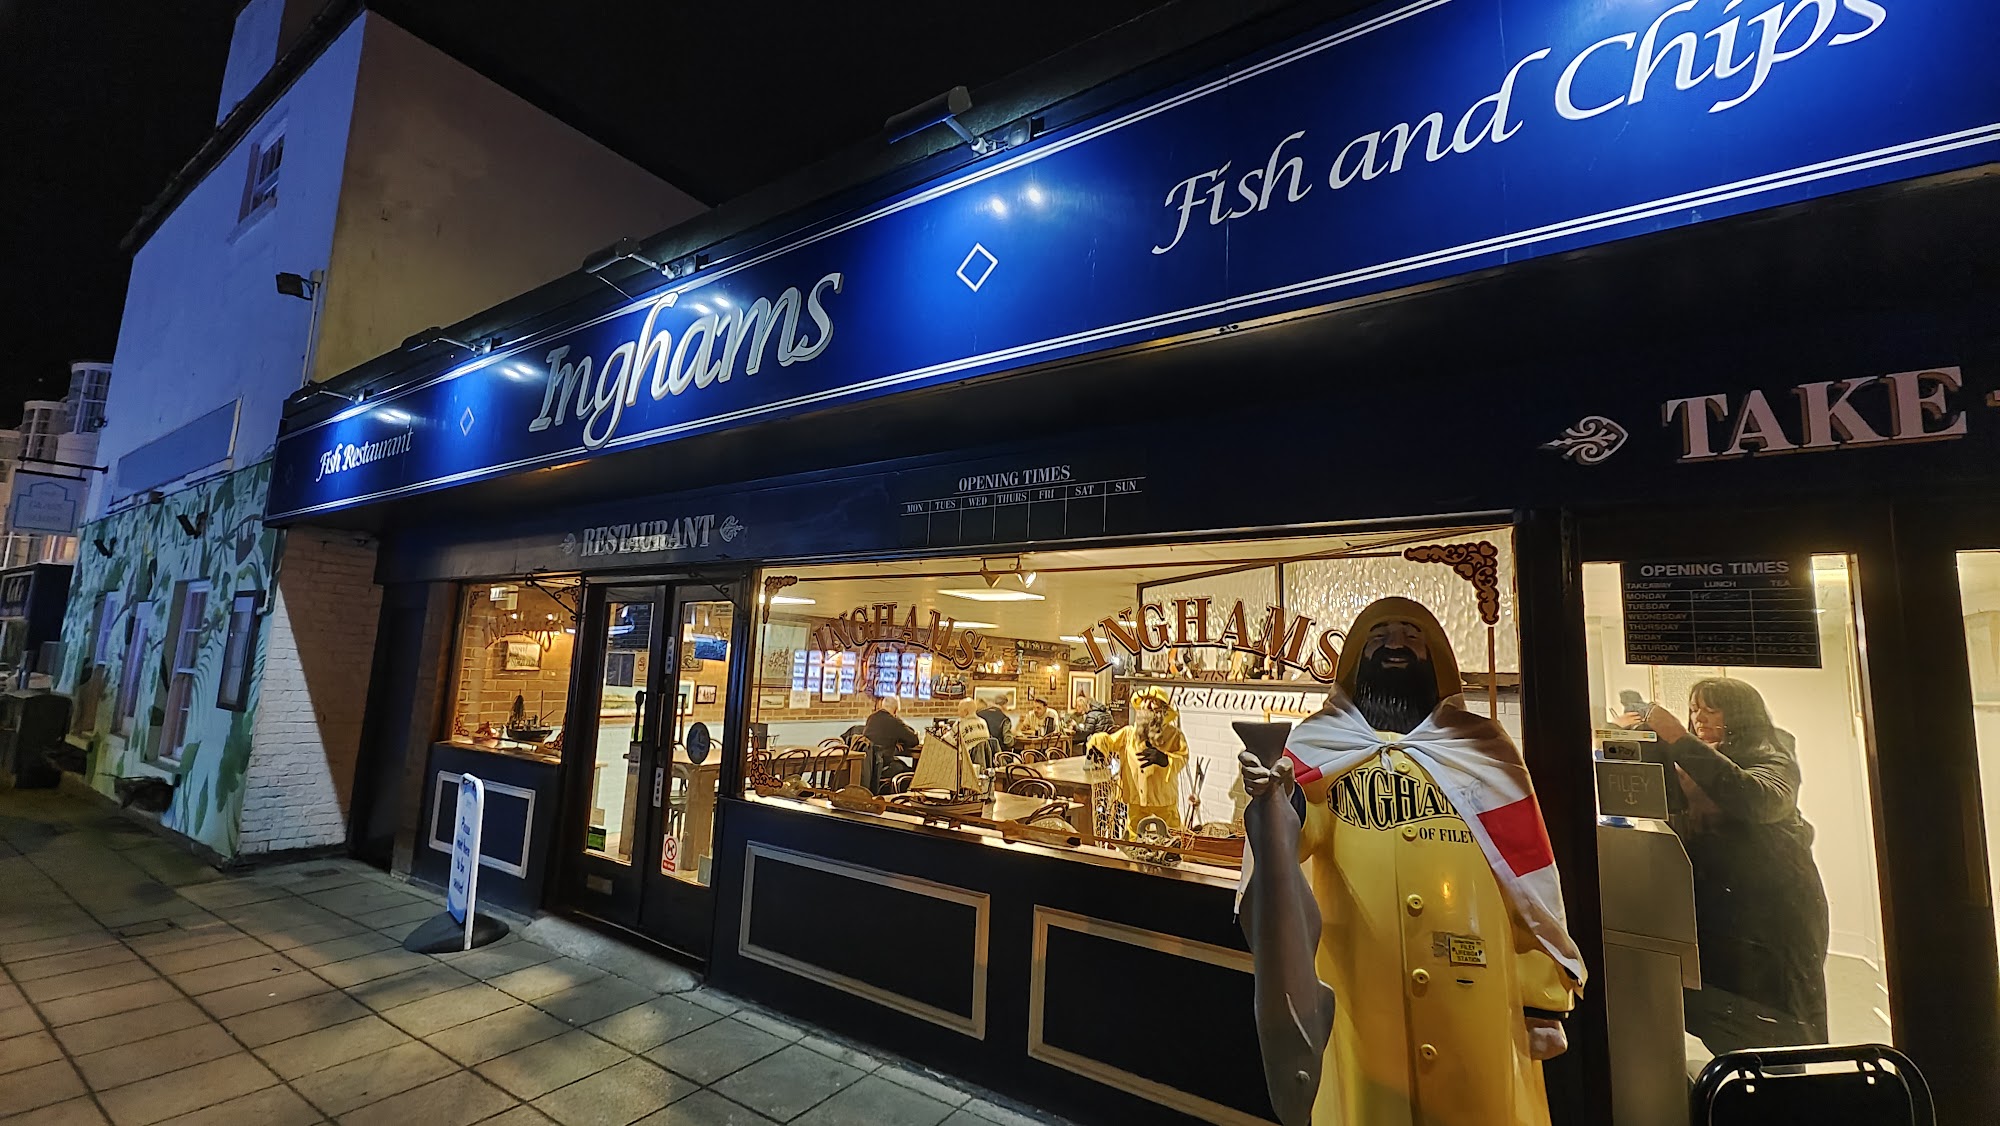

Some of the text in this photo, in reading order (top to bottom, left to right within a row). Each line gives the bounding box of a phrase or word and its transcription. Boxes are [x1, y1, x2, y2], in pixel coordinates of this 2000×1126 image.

[1152, 0, 1887, 254] Fish and Chips
[528, 272, 845, 450] Inghams
[1661, 365, 1968, 463] TAKE
[315, 427, 414, 482] Fish Restaurant
[958, 464, 1071, 492] OPENING TIMES
[906, 480, 1138, 514] MON TUES WED THURS FRI SAT SUN
[581, 514, 715, 557] RESTAURANT
[1640, 560, 1790, 577] OPENING TIMES
[1703, 580, 1737, 588] LUNCH
[1770, 579, 1791, 588] TEA
[1626, 592, 1668, 600] MONDAY
[812, 601, 984, 670] INGHAMS
[1629, 623, 1680, 631] THURSDAY
[1629, 633, 1662, 641] FRIDAY
[1079, 596, 1346, 684] INGHAMS
[1629, 643, 1681, 652] SATURDAY
[1630, 654, 1670, 662] SUNDAY
[1608, 774, 1649, 792] FILEY
[1419, 827, 1436, 840] OF
